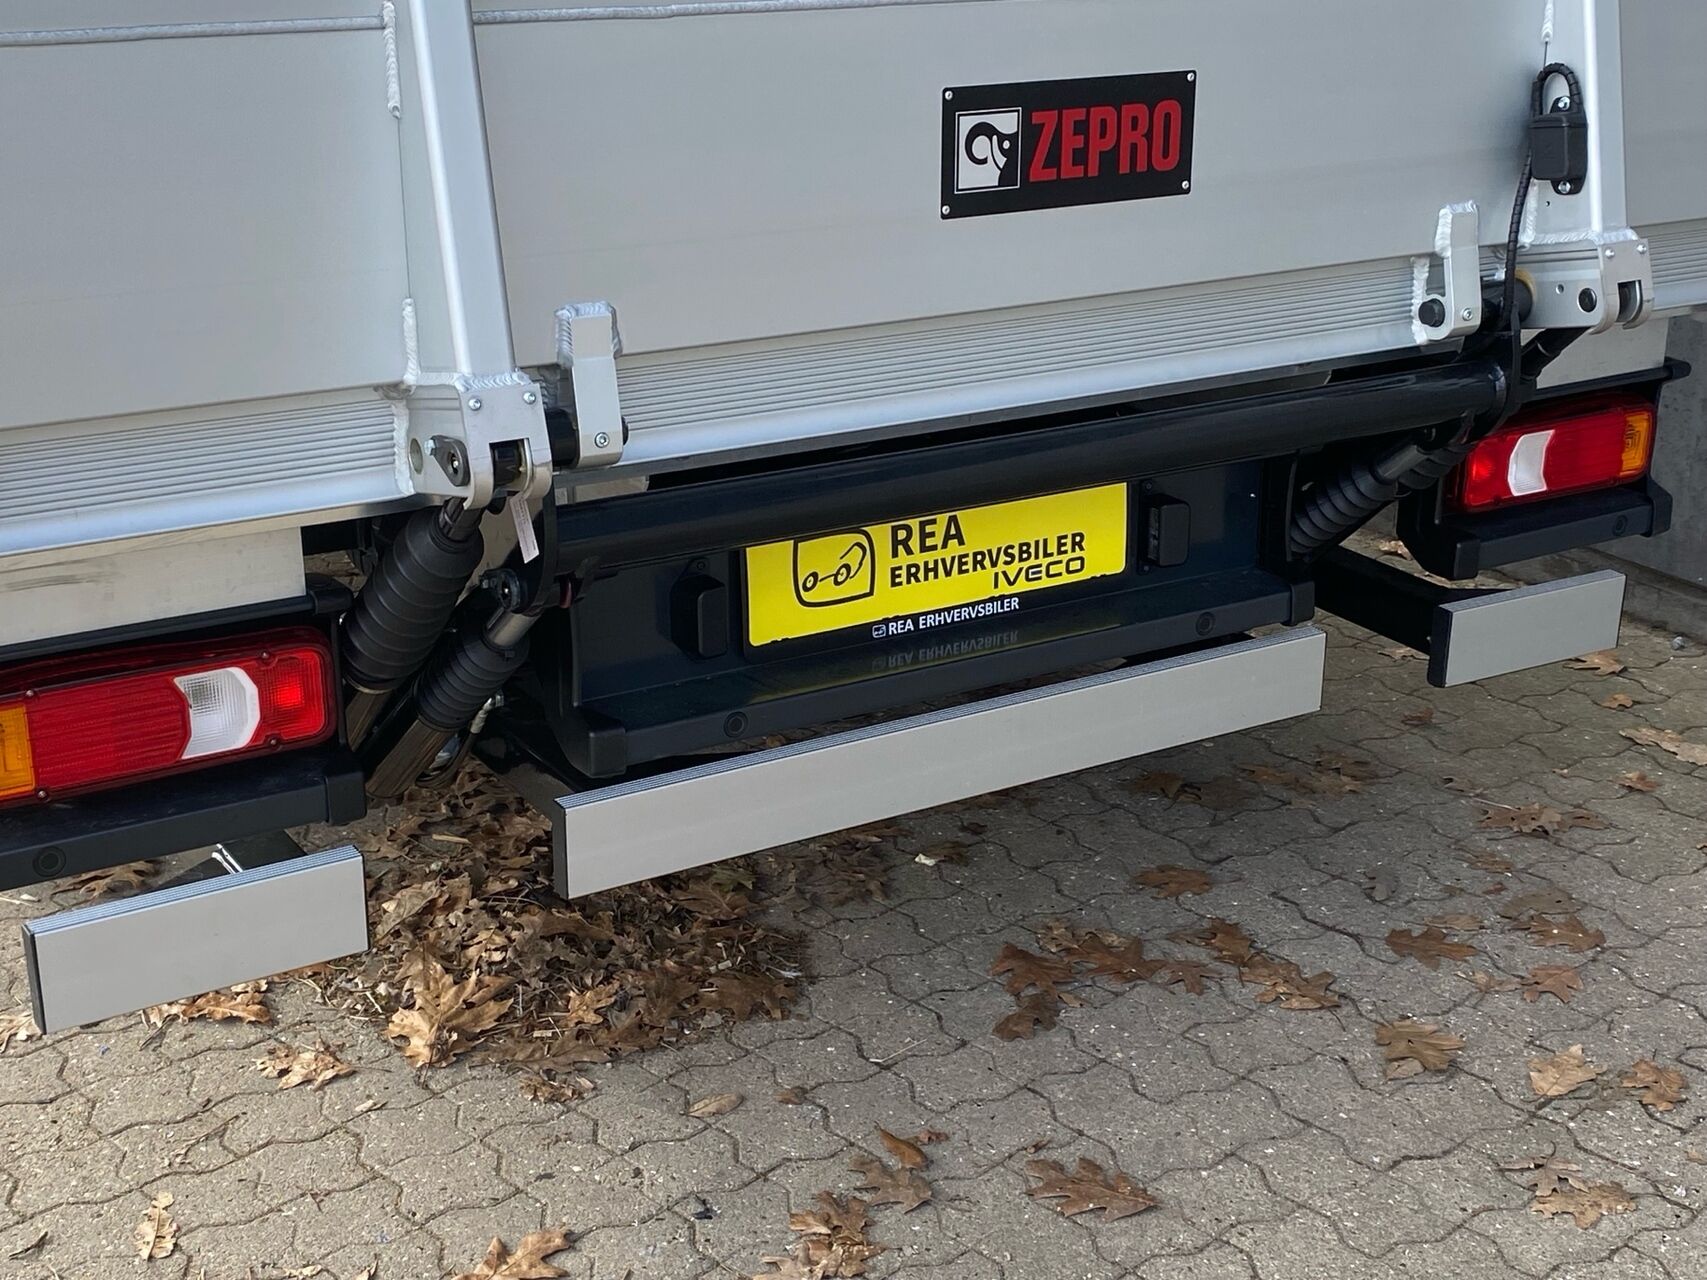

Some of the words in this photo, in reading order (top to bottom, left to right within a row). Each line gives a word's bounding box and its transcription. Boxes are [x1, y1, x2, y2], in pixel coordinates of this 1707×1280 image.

[1029, 99, 1182, 182] ZEPRO
[890, 514, 966, 559] REA
[890, 531, 1086, 588] ERHVERVSBILER
[993, 556, 1085, 589] IVECO
[888, 619, 914, 636] REA
[918, 597, 1020, 629] ERHVERVSBILER
